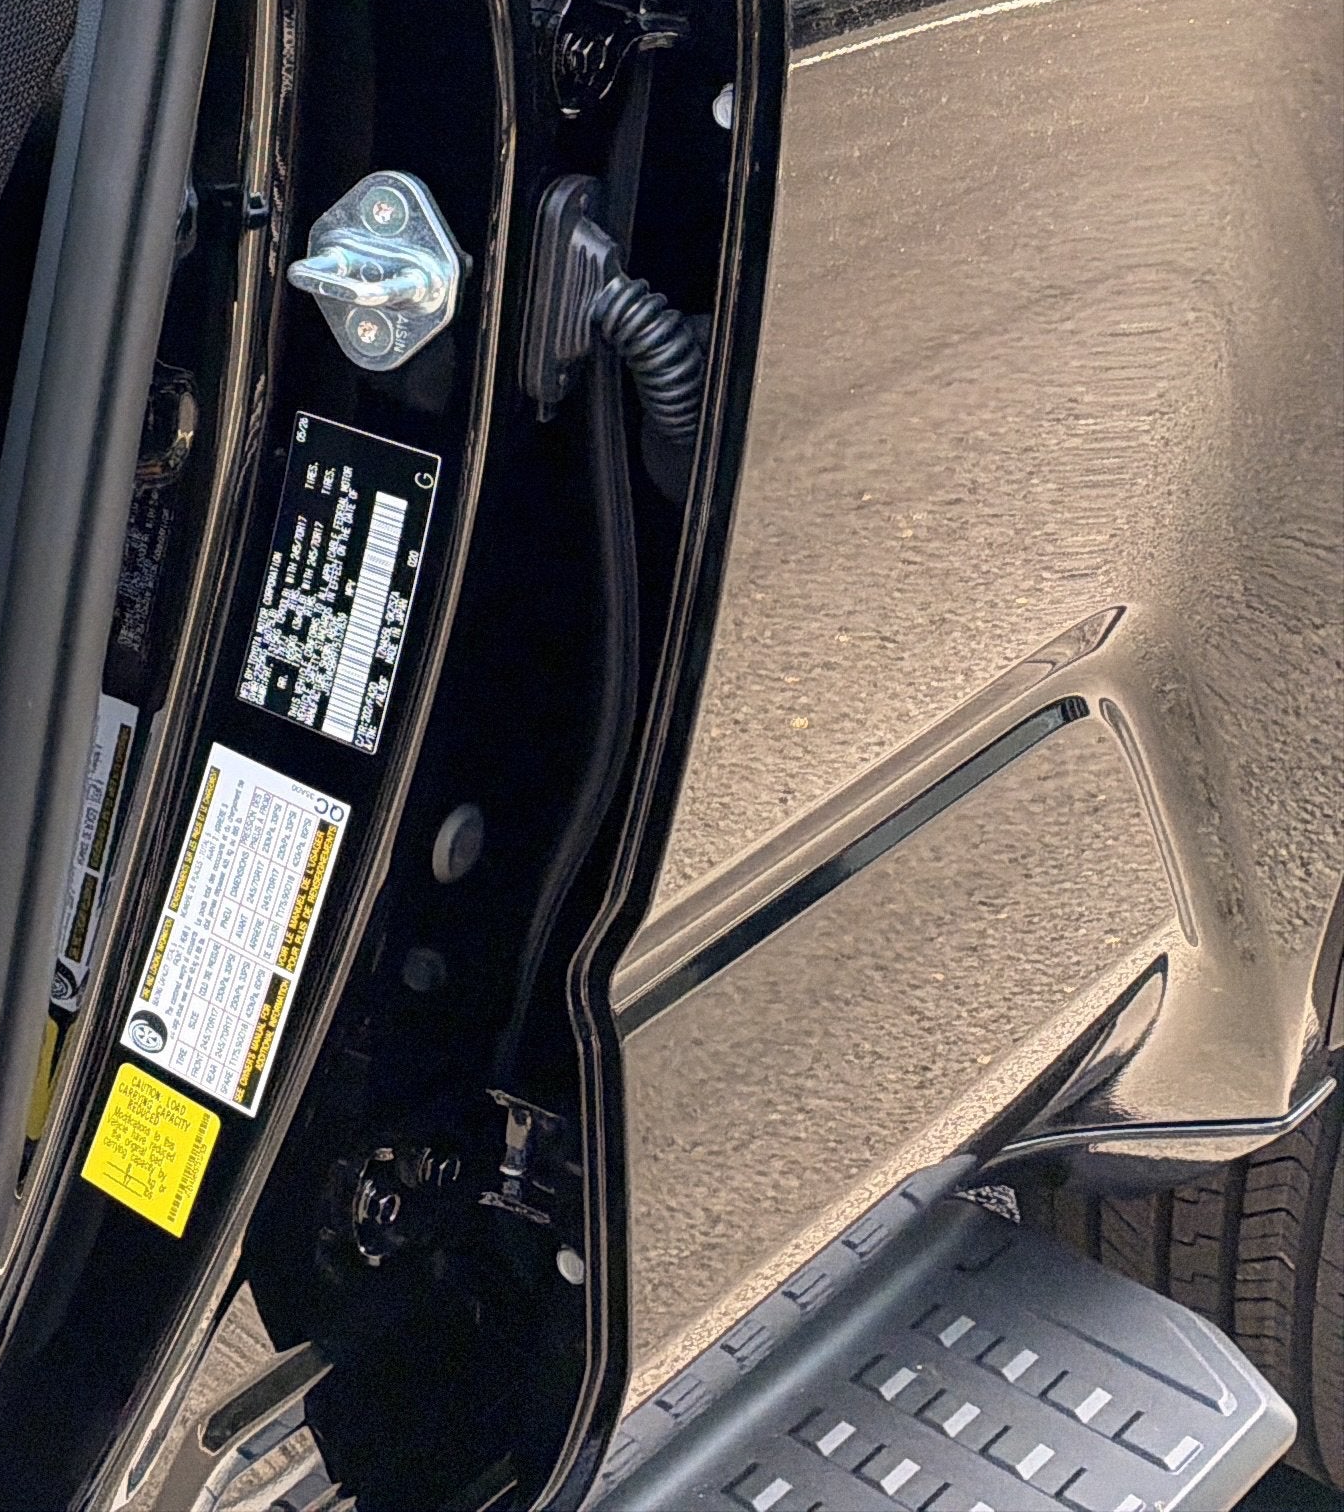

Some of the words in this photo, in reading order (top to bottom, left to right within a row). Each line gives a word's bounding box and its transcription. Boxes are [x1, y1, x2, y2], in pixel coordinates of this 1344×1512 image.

[393, 314, 409, 354] AISIN
[338, 464, 353, 493] MOTOR
[289, 514, 308, 561] 245/70R17
[305, 520, 325, 567] 245/70R17
[262, 550, 282, 606] CORPORATION
[239, 808, 257, 846] PRESSION
[250, 791, 262, 809] DES
[247, 823, 262, 850] PNEUS
[258, 791, 271, 816] FROID
[269, 802, 283, 825] 33PSI
[284, 809, 298, 833] 33PSI
[312, 795, 346, 823] QC
[305, 830, 325, 874] L'USAGER
[306, 824, 337, 903] RENSEIGNEMENTS
[228, 849, 250, 898] DIMENSIONS
[245, 859, 265, 904] 245/70R17
[300, 875, 311, 891] DE
[259, 866, 280, 912] 245/70R17
[218, 906, 232, 929] PNEU
[288, 891, 306, 929] MANUEL
[301, 904, 312, 919] DE
[234, 912, 249, 939] AVANT
[283, 930, 294, 944] LE
[293, 919, 307, 945] PLUS
[276, 944, 289, 968] VOIR
[285, 945, 300, 973] POUR
[187, 1009, 199, 1030] SIZE
[254, 1027, 274, 1072] ADDITIONAL
[268, 978, 290, 1028] INFORMATION
[259, 1002, 271, 1021] FOR
[199, 1006, 219, 1050] 245/70R17
[213, 1014, 234, 1059] 245/70R17
[250, 1019, 266, 1052] MANUAL
[175, 1046, 188, 1067] TIRE
[189, 1051, 204, 1078] FRONT
[238, 1050, 256, 1087] OWNER'S
[205, 1062, 218, 1085] REAR
[219, 1069, 233, 1095] SPARE
[117, 1080, 155, 1110] CARRYING
[154, 1103, 191, 1133] CAPACITY
[165, 1095, 187, 1116] LOAD
[233, 1085, 245, 1103] SEE
[126, 1098, 161, 1127] REDUCED
